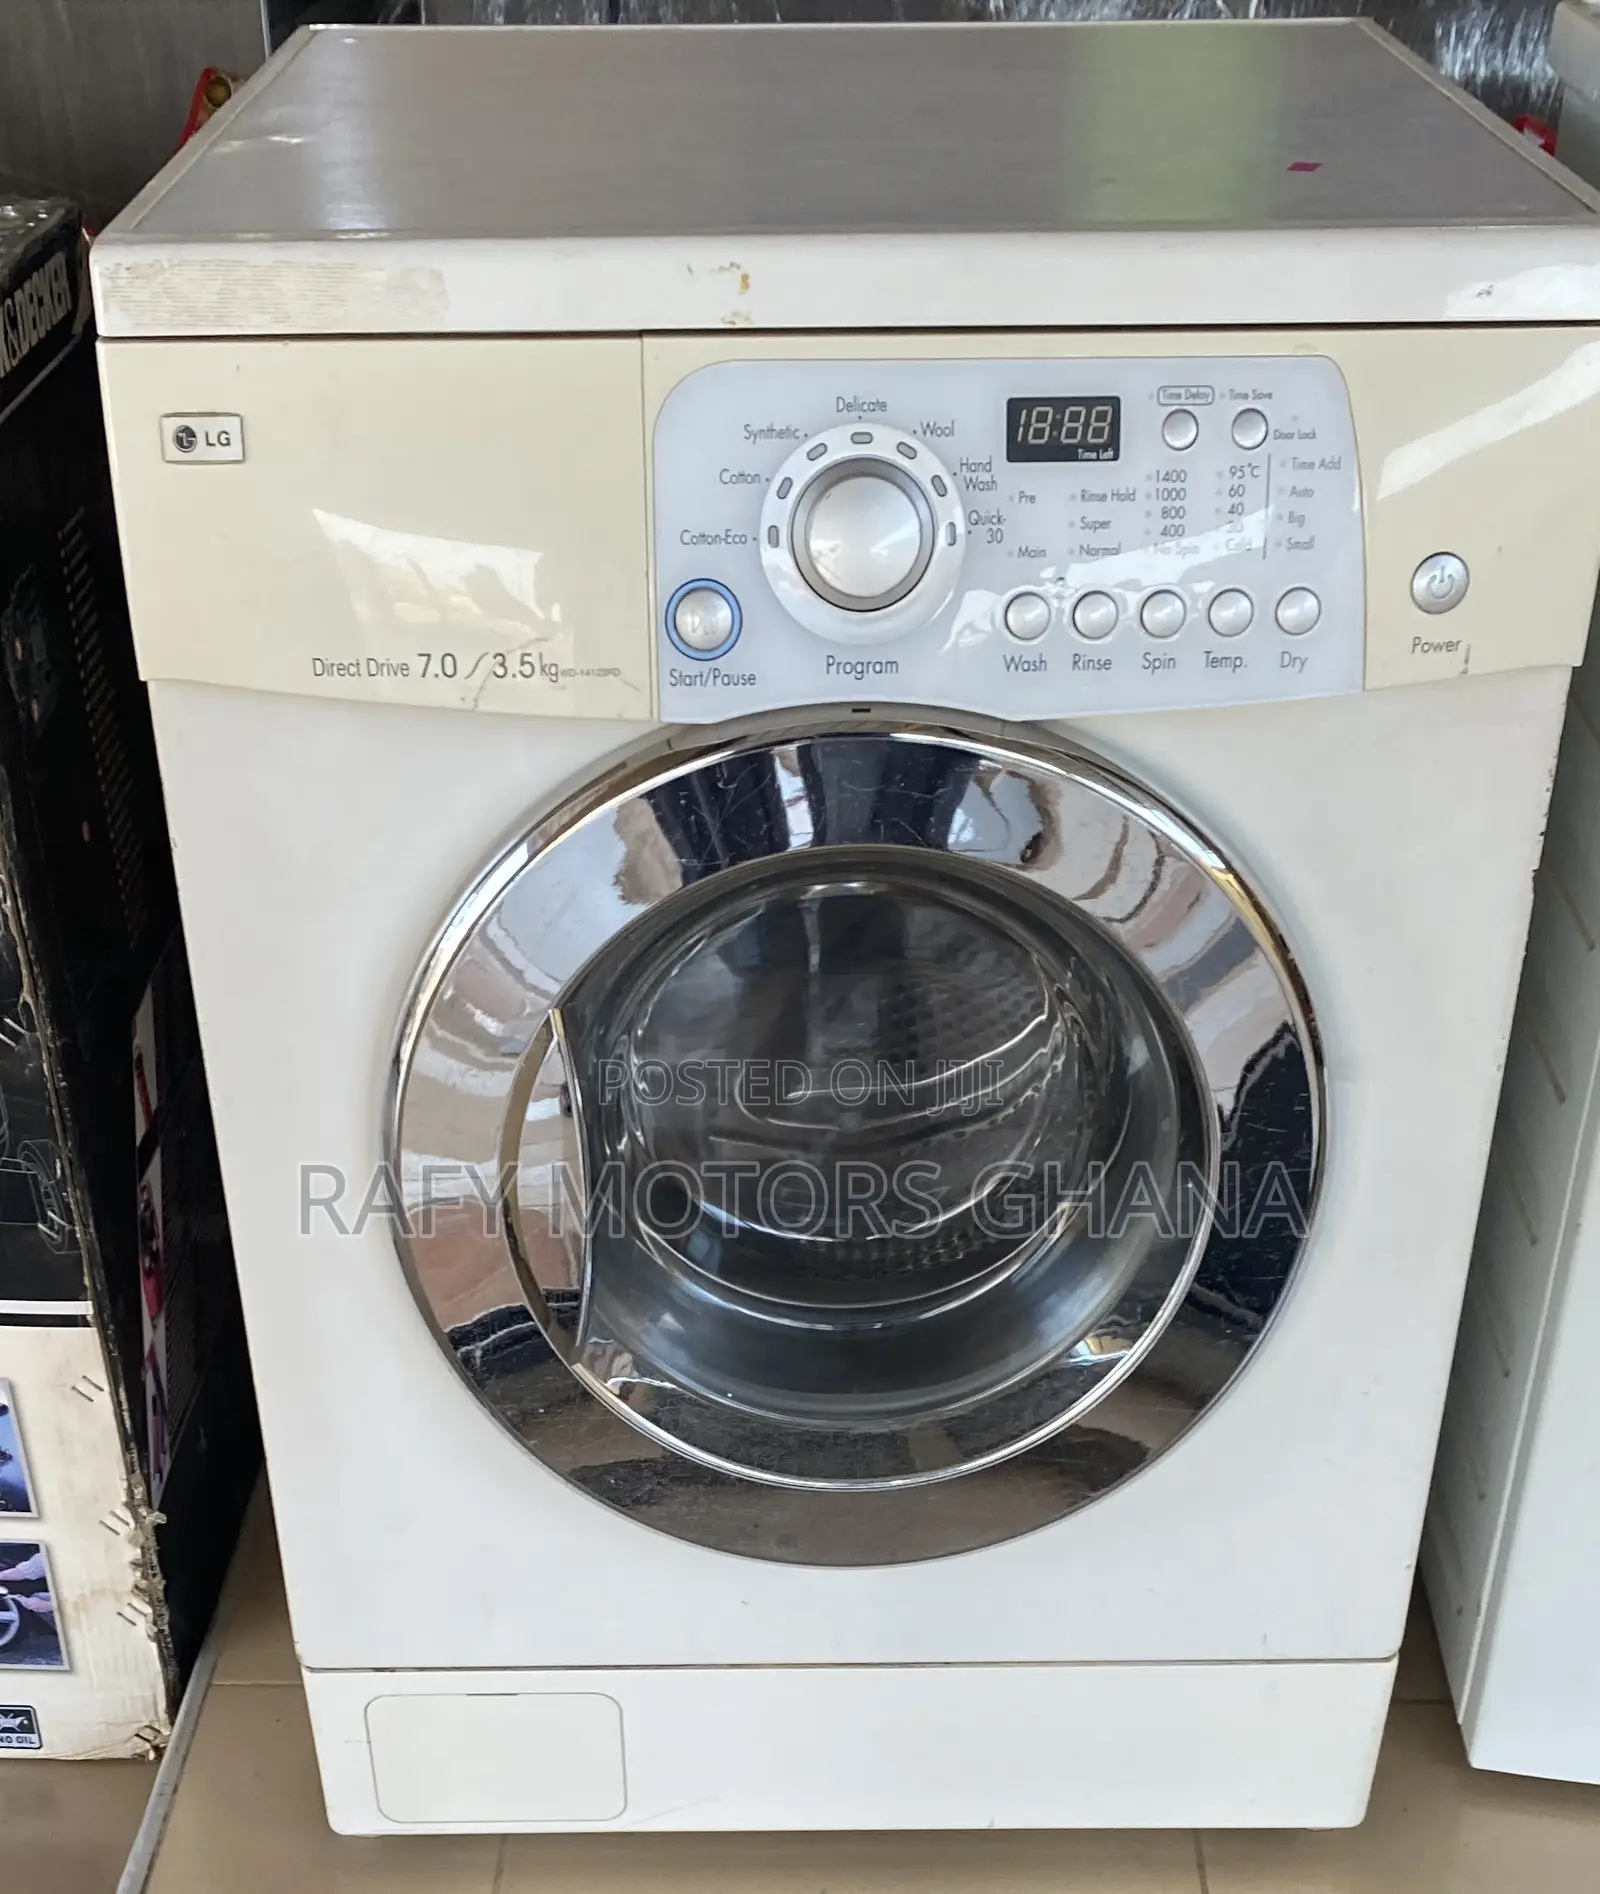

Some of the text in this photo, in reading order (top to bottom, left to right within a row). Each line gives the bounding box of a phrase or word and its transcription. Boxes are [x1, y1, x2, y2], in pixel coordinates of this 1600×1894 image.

[1162, 388, 1211, 403] Time Delay
[1229, 389, 1273, 400] Time Save
[836, 396, 888, 414] Delicate
[744, 424, 800, 443] Synthetic
[920, 420, 955, 437] Wool
[1273, 428, 1316, 440] Door Lock
[205, 429, 231, 447] LG
[1077, 447, 1114, 459] Time Left
[960, 456, 992, 474] Hand
[1291, 456, 1341, 471] Time Add
[719, 468, 761, 485] Cotton
[1155, 469, 1188, 483] 1400
[963, 476, 997, 493] Wash
[1228, 484, 1245, 498] 60
[1289, 486, 1314, 498] Auto
[1018, 490, 1036, 504] Pre
[1080, 486, 1136, 502] Rinse Hold
[1155, 487, 1187, 501] 1000
[1161, 505, 1186, 519] 800
[1227, 502, 1245, 516] 40
[968, 510, 1006, 529] Quick-
[1080, 516, 1112, 533] Super
[1288, 511, 1305, 527] Big
[680, 529, 748, 547] Cotton-Eco
[986, 528, 1004, 544] 30
[1160, 524, 1186, 538] 400
[1079, 542, 1121, 557] Normal
[1286, 535, 1316, 551] Small
[1017, 545, 1047, 558] Main
[1411, 636, 1463, 654] Power
[312, 657, 361, 677] Direct
[366, 657, 410, 677] Drive
[417, 653, 458, 679] 7.0
[492, 652, 536, 679] 3.5
[539, 652, 559, 683] kg
[825, 655, 899, 680] Program
[1003, 654, 1048, 672] Wash
[1072, 653, 1112, 672] Rinse
[1142, 651, 1176, 675] Spin
[1203, 650, 1248, 674] Temp.
[1280, 651, 1308, 673] Dry
[669, 668, 757, 688] Start/Pause
